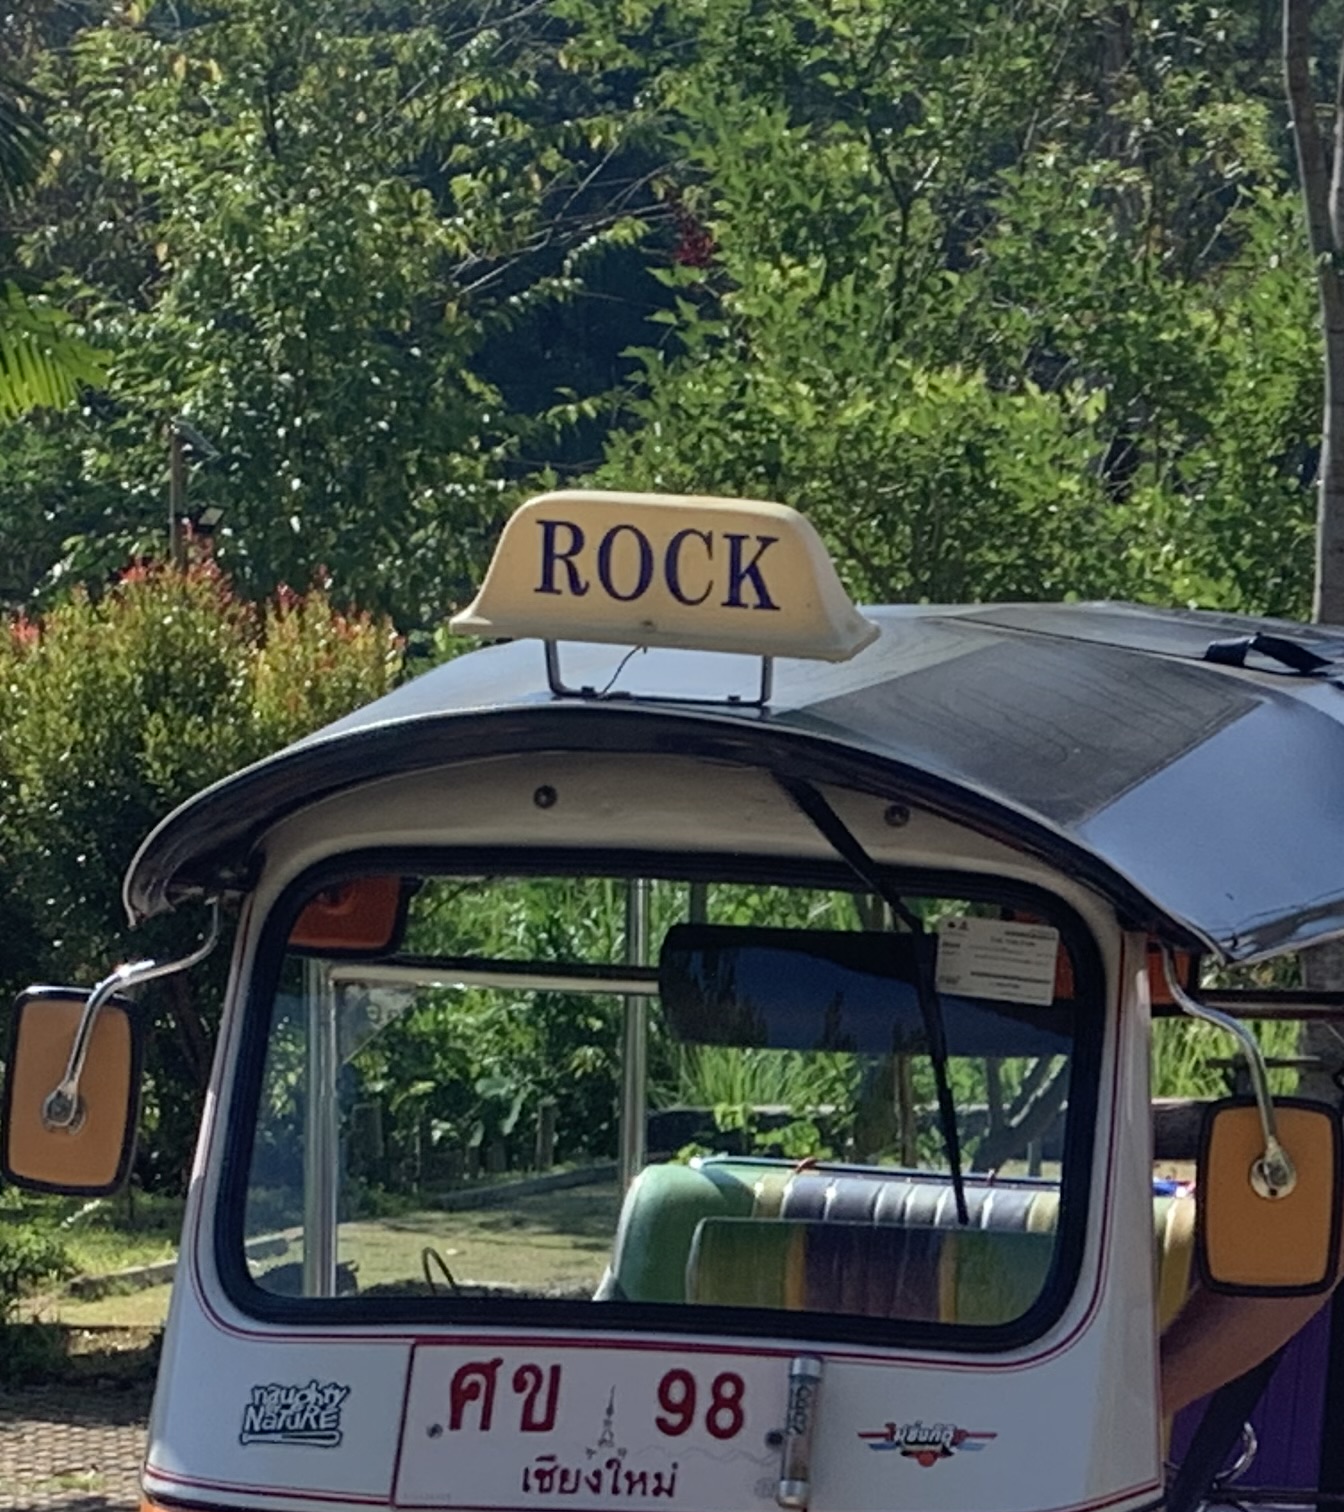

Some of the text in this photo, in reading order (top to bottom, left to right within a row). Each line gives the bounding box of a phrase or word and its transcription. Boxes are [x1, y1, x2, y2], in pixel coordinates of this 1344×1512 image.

[533, 519, 781, 611] ROCK
[449, 1357, 745, 1440] ศข 98
[521, 1454, 678, 1498] เชียงใหม่
